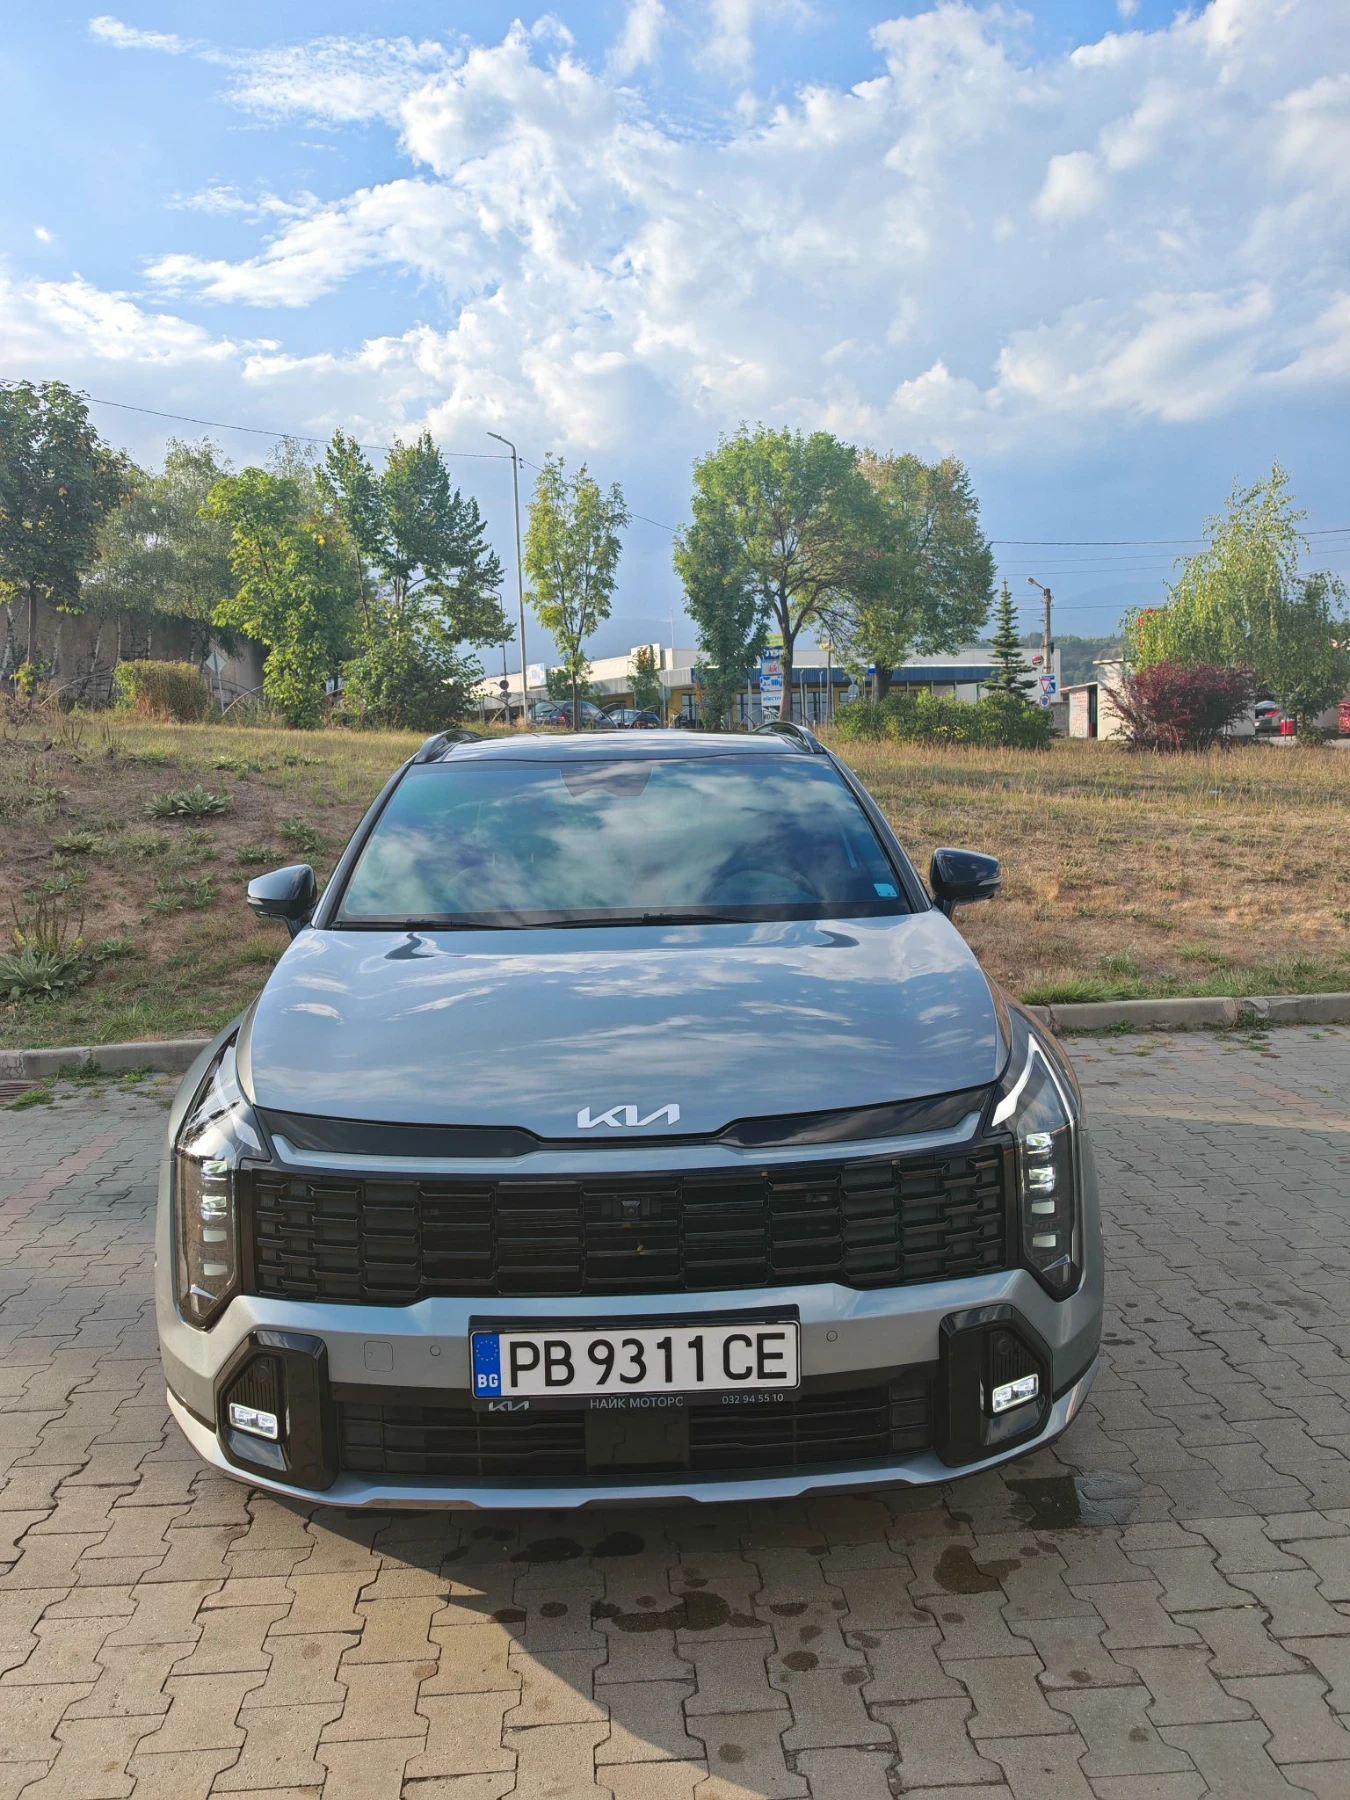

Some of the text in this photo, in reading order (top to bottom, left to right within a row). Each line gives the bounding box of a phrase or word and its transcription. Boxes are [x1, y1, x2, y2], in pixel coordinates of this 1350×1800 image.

[577, 1103, 681, 1128] KIA
[508, 1332, 788, 1388] PB 9311 CE
[477, 1373, 499, 1389] BG
[590, 1396, 684, 1409] НАЙК МОТОРС
[722, 1393, 784, 1404] 032 94 55 10
[488, 1400, 530, 1412] KIA
